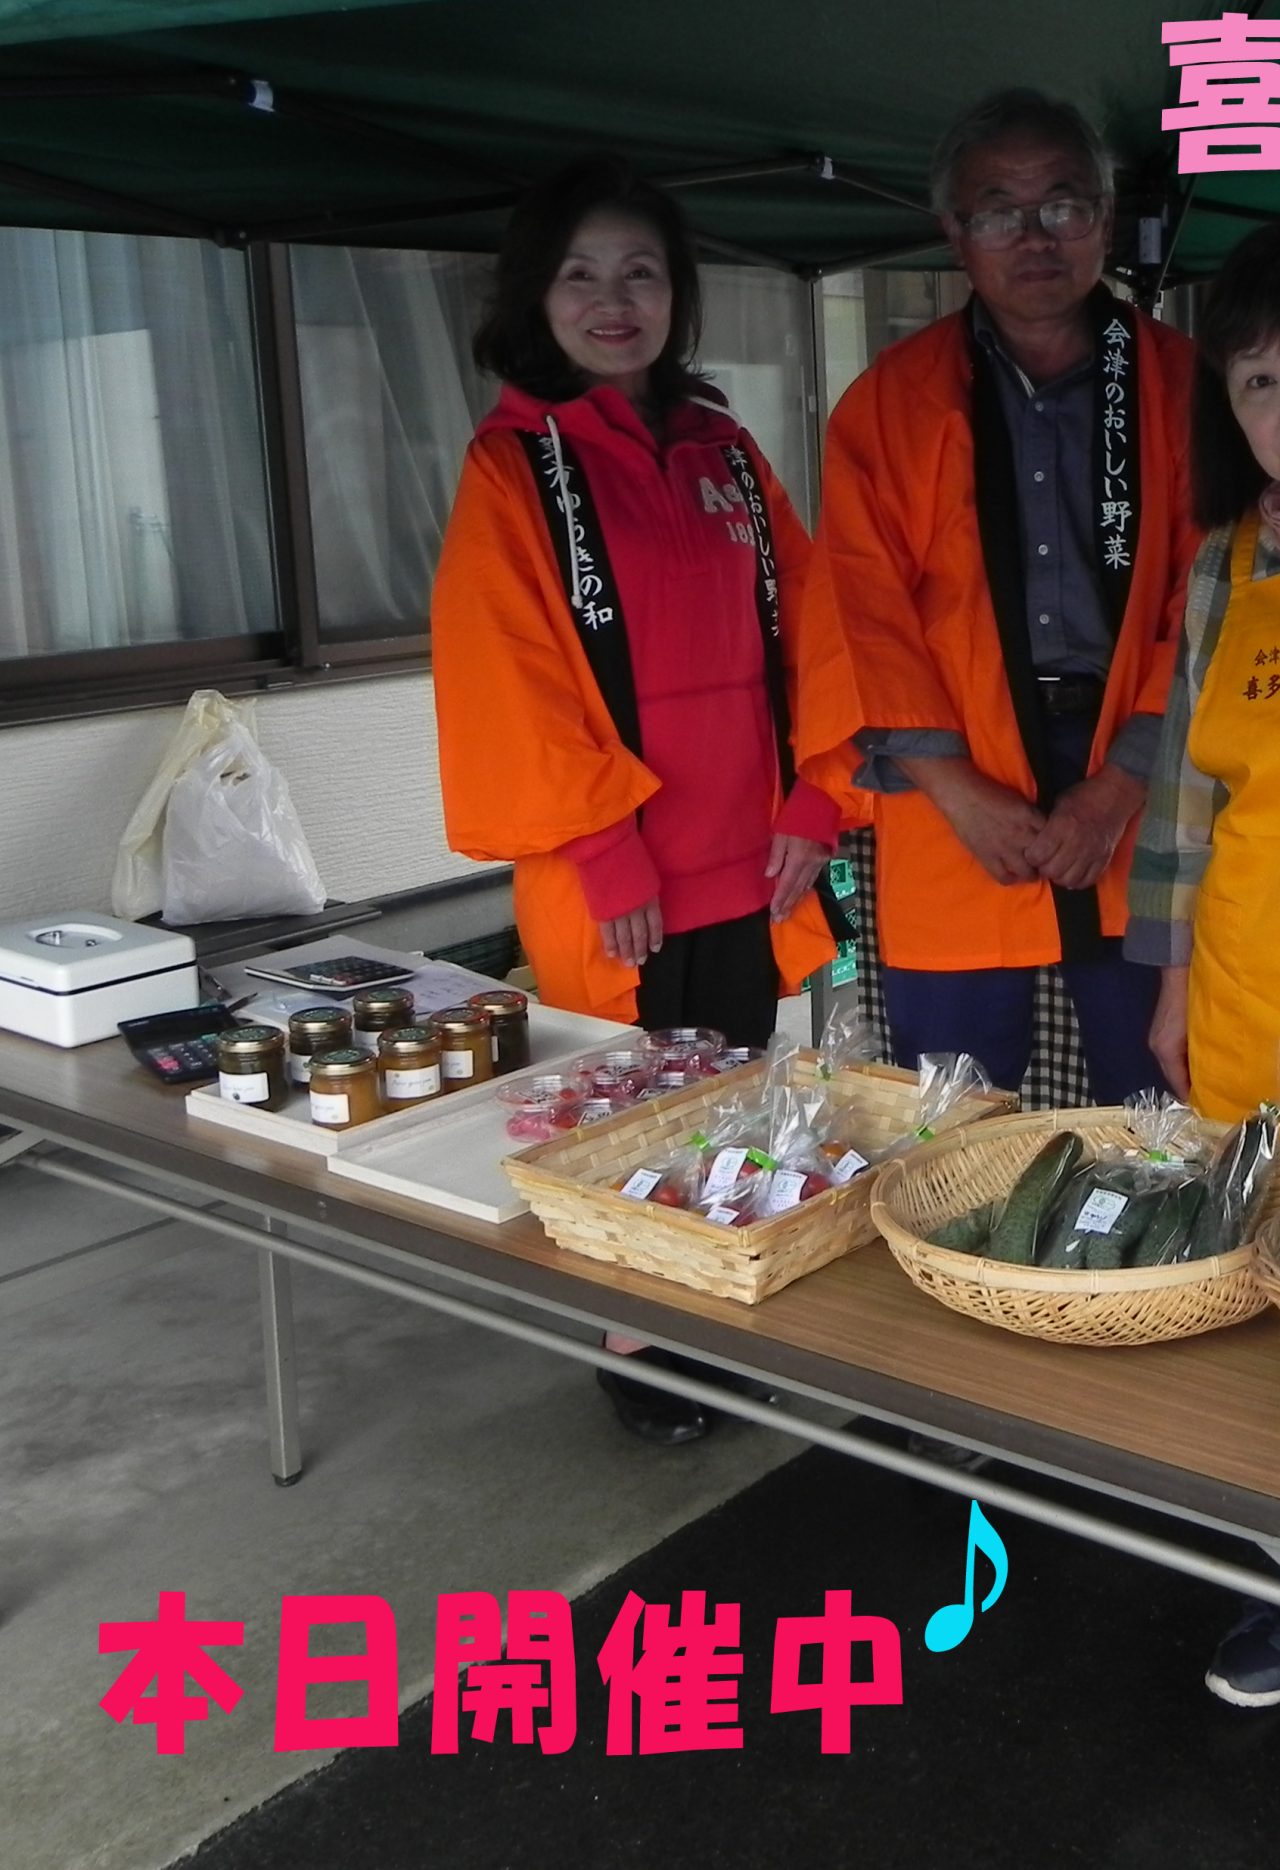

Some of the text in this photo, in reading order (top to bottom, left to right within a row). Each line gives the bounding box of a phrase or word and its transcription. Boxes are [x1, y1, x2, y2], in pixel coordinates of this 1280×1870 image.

[1101, 318, 1132, 570] 会津のおいしい野菜
